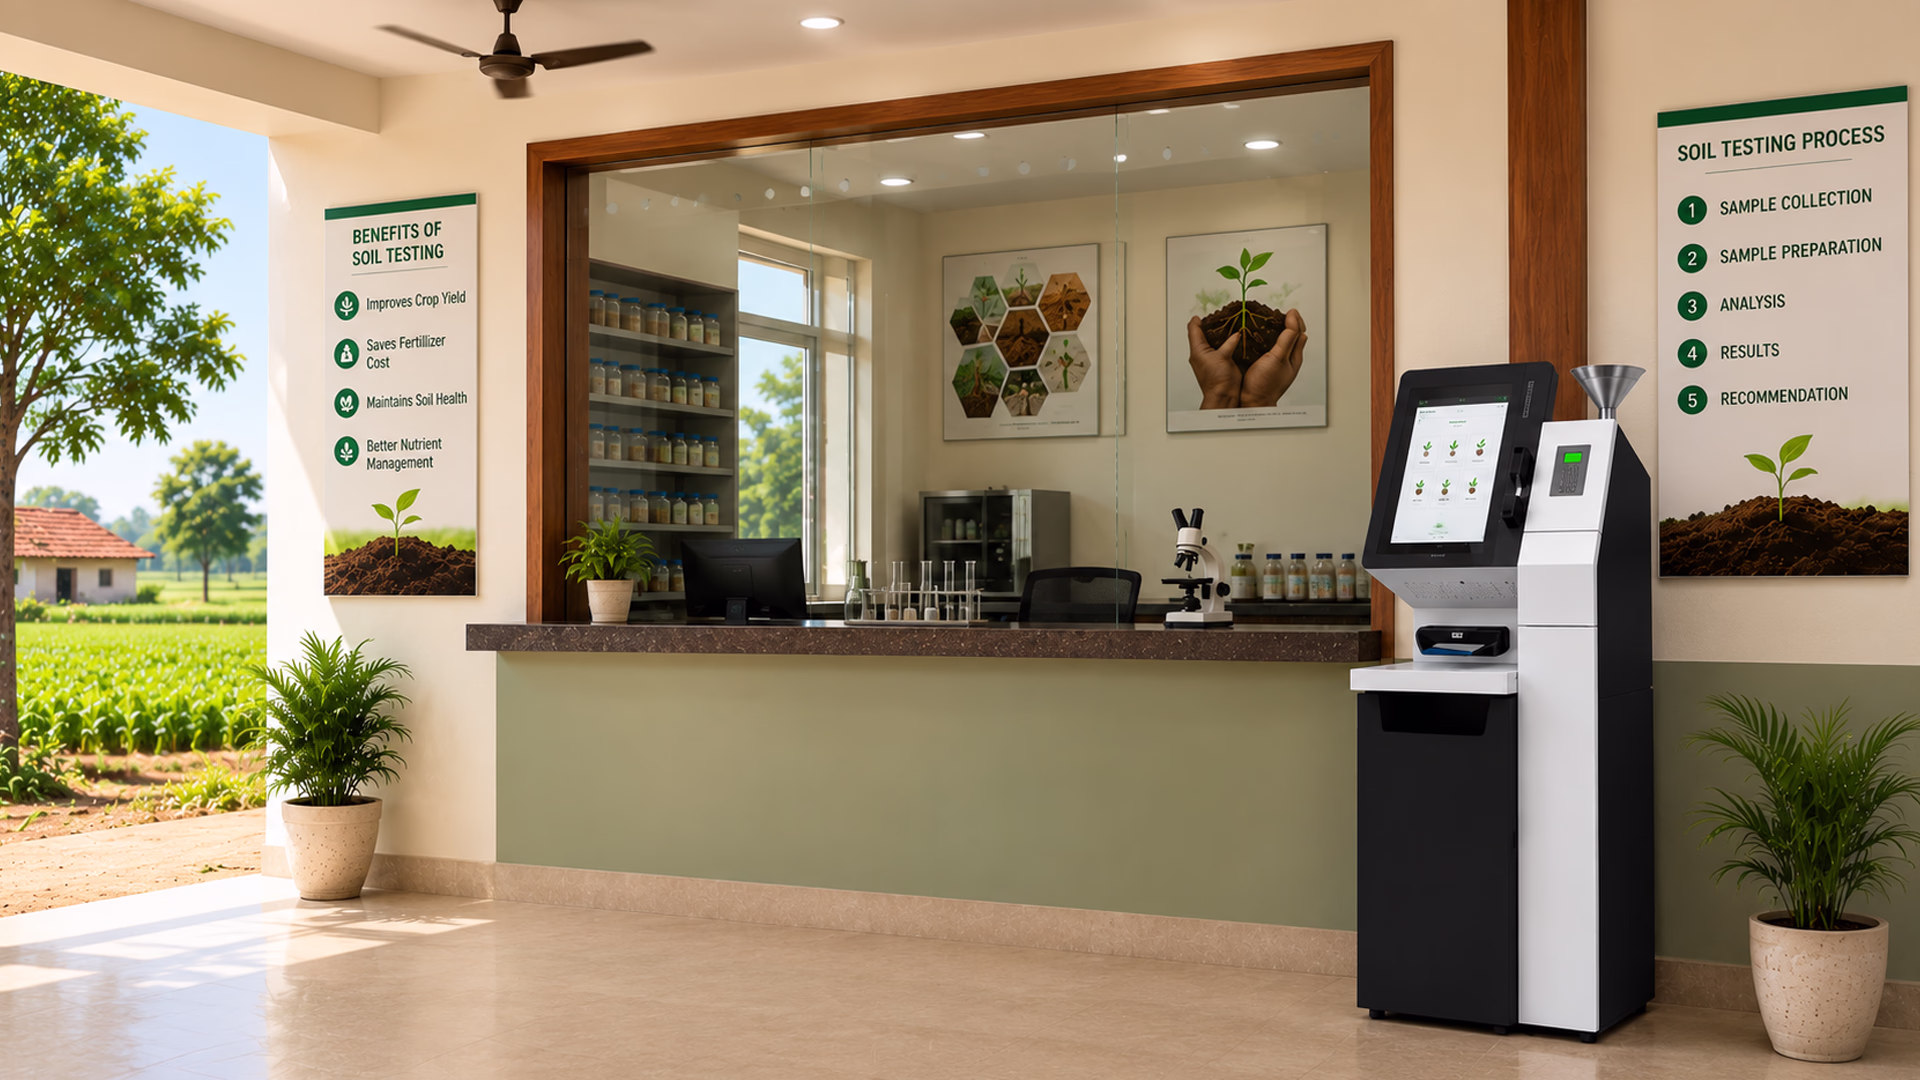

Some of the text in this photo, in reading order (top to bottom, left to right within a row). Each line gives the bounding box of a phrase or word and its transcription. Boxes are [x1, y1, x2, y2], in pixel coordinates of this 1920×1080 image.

[1678, 125, 1884, 161] SOIL TESTING PROCESS
[1688, 188, 1871, 217] 1 SAMPLE COLLECTION
[353, 221, 441, 245] BENEFITS OF
[353, 244, 443, 266] SOIL TESTING
[1687, 237, 1881, 265] 2 SAMPLE PREPARATION
[367, 291, 466, 312] Improves Crop Yield
[1687, 294, 1785, 313] 3 ANALYSIS
[367, 339, 396, 351] Saves
[1687, 343, 1779, 360] 4 RESULTS
[367, 356, 389, 369] Cost
[367, 391, 467, 408] Maintains Soil Health
[1688, 386, 1848, 407] 5 RECOMMENDATION
[367, 438, 442, 452] Better Nutrient
[367, 456, 433, 472] Management
